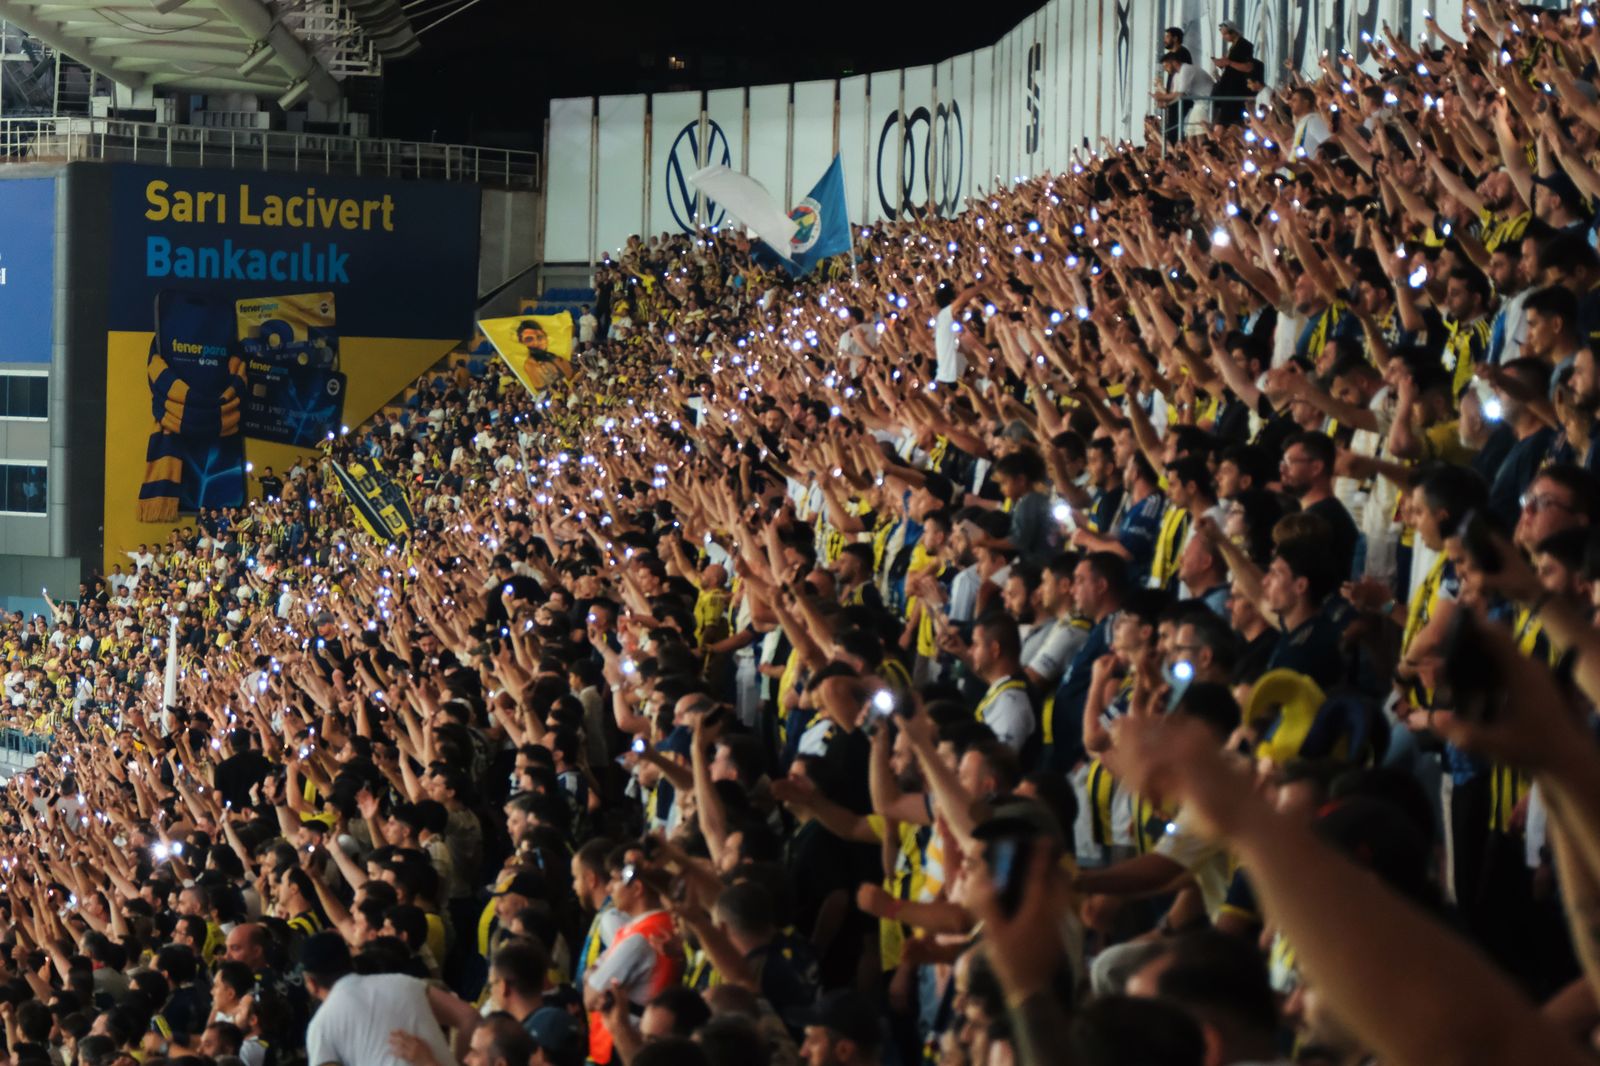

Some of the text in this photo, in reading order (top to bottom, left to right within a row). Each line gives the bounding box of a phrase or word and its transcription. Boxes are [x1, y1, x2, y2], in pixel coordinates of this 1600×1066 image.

[145, 179, 395, 232] Sarı Lacivert
[146, 236, 350, 283] Bankacılık
